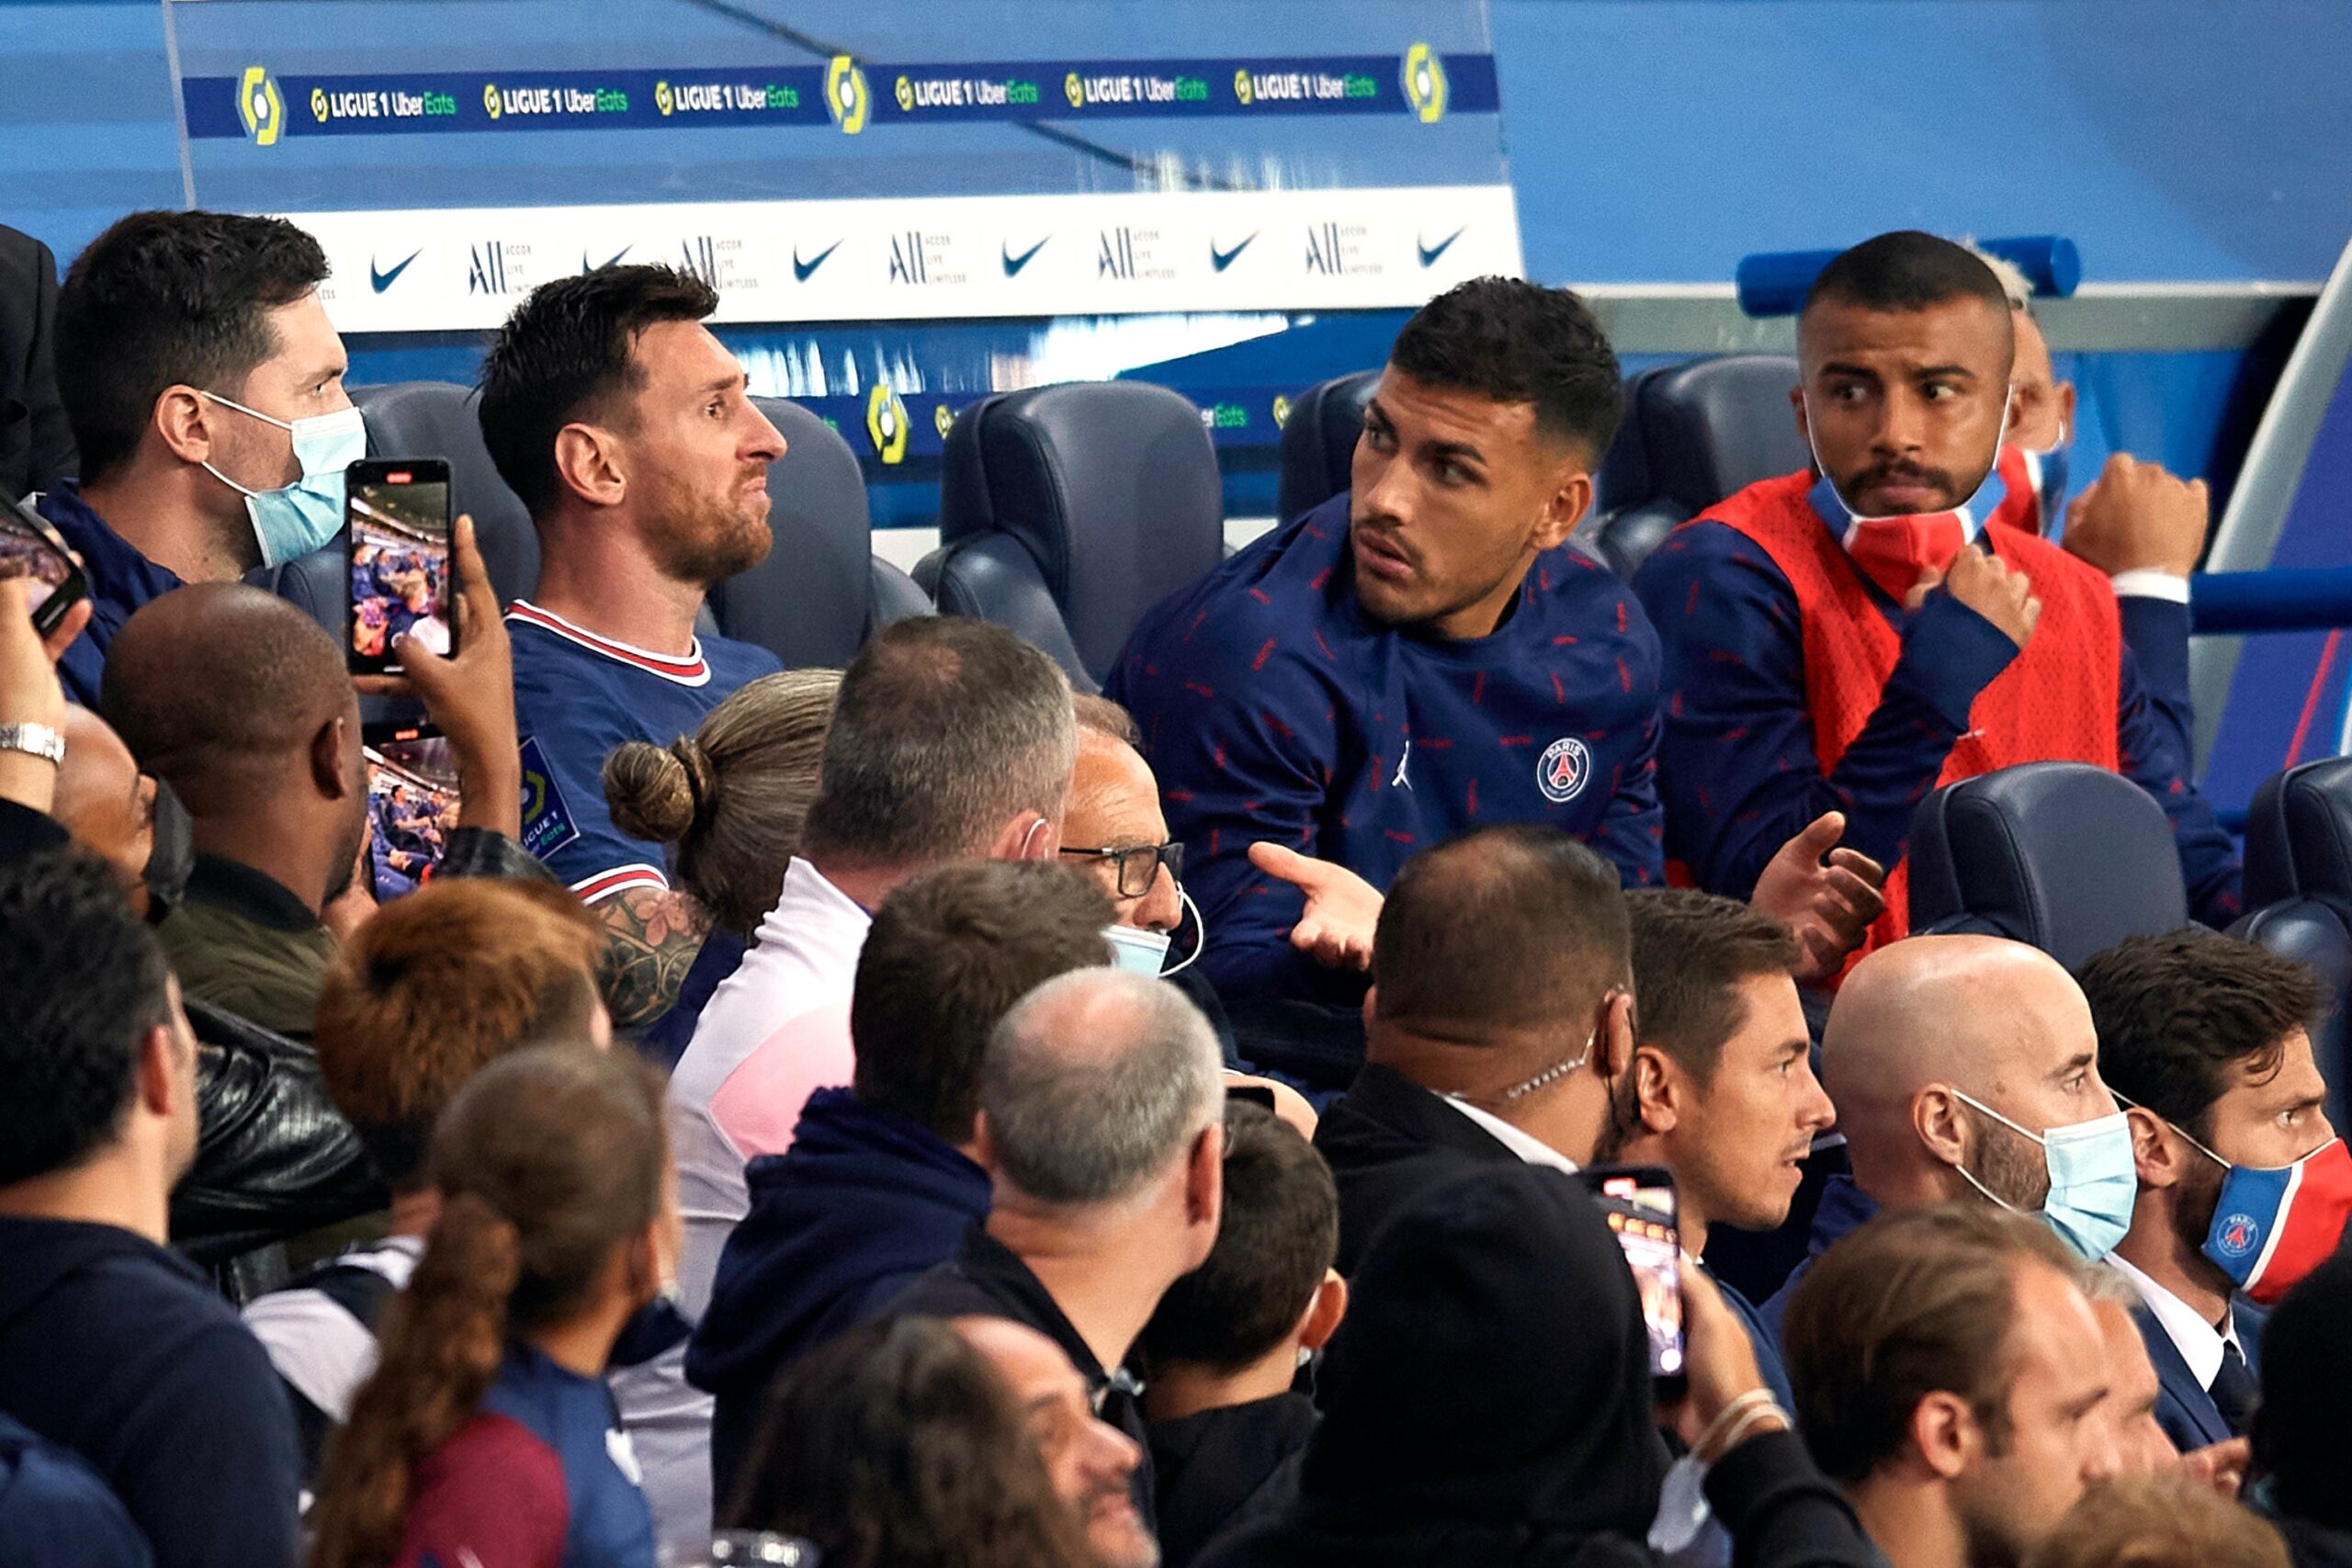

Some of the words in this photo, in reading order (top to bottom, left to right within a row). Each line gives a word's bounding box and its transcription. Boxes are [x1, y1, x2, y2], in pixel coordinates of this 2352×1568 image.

[674, 85, 723, 111] LIGUE
[723, 85, 732, 110] 1
[915, 79, 963, 107] LIGUE
[964, 80, 973, 106] 1
[1084, 76, 1133, 103] LIGUE
[1133, 77, 1142, 102] 1
[1253, 73, 1301, 100] LIGUE
[1302, 75, 1310, 99] 1
[330, 92, 379, 117] LIGUE
[379, 92, 389, 117] 1
[503, 88, 551, 114] LIGUE
[552, 89, 561, 113] 1
[1546, 741, 1581, 759] PARIS
[524, 817, 550, 846] IGUE
